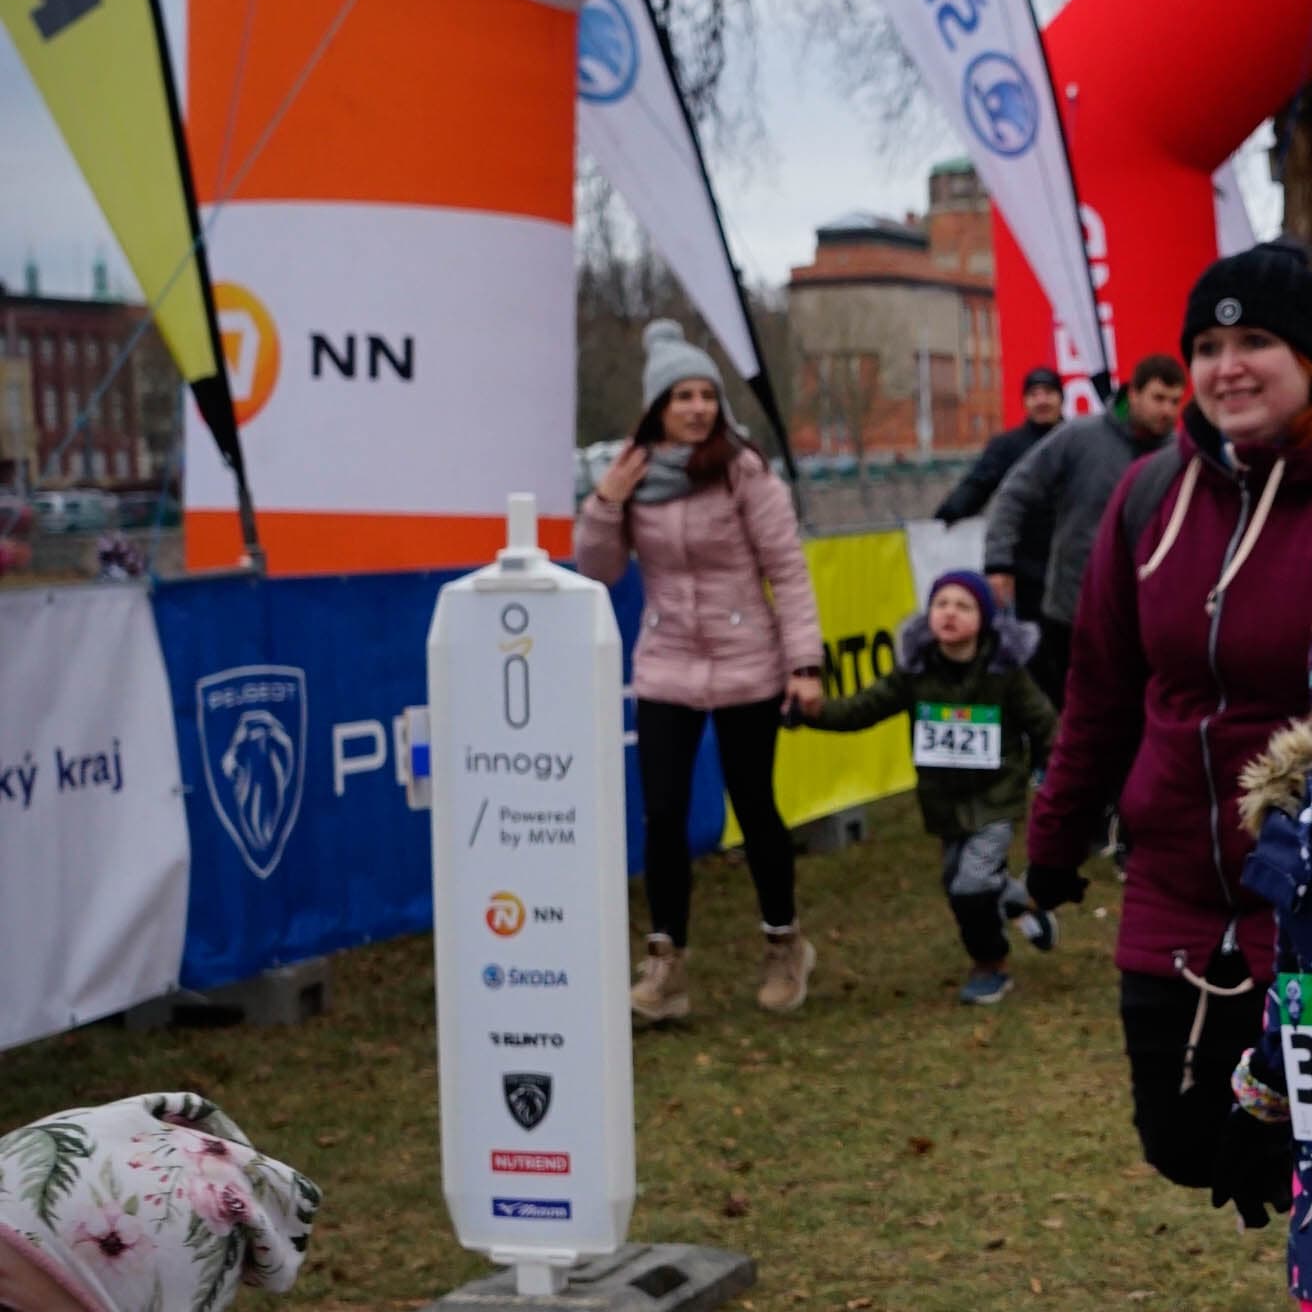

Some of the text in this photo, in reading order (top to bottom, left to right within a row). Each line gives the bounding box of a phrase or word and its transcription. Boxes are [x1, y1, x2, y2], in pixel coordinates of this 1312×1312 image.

[309, 331, 416, 381] NN
[922, 724, 990, 754] 3421
[54, 738, 124, 794] kraj
[465, 745, 574, 782] innogy
[500, 805, 577, 824] Powered
[528, 829, 577, 845] MVM
[534, 906, 564, 923] NN
